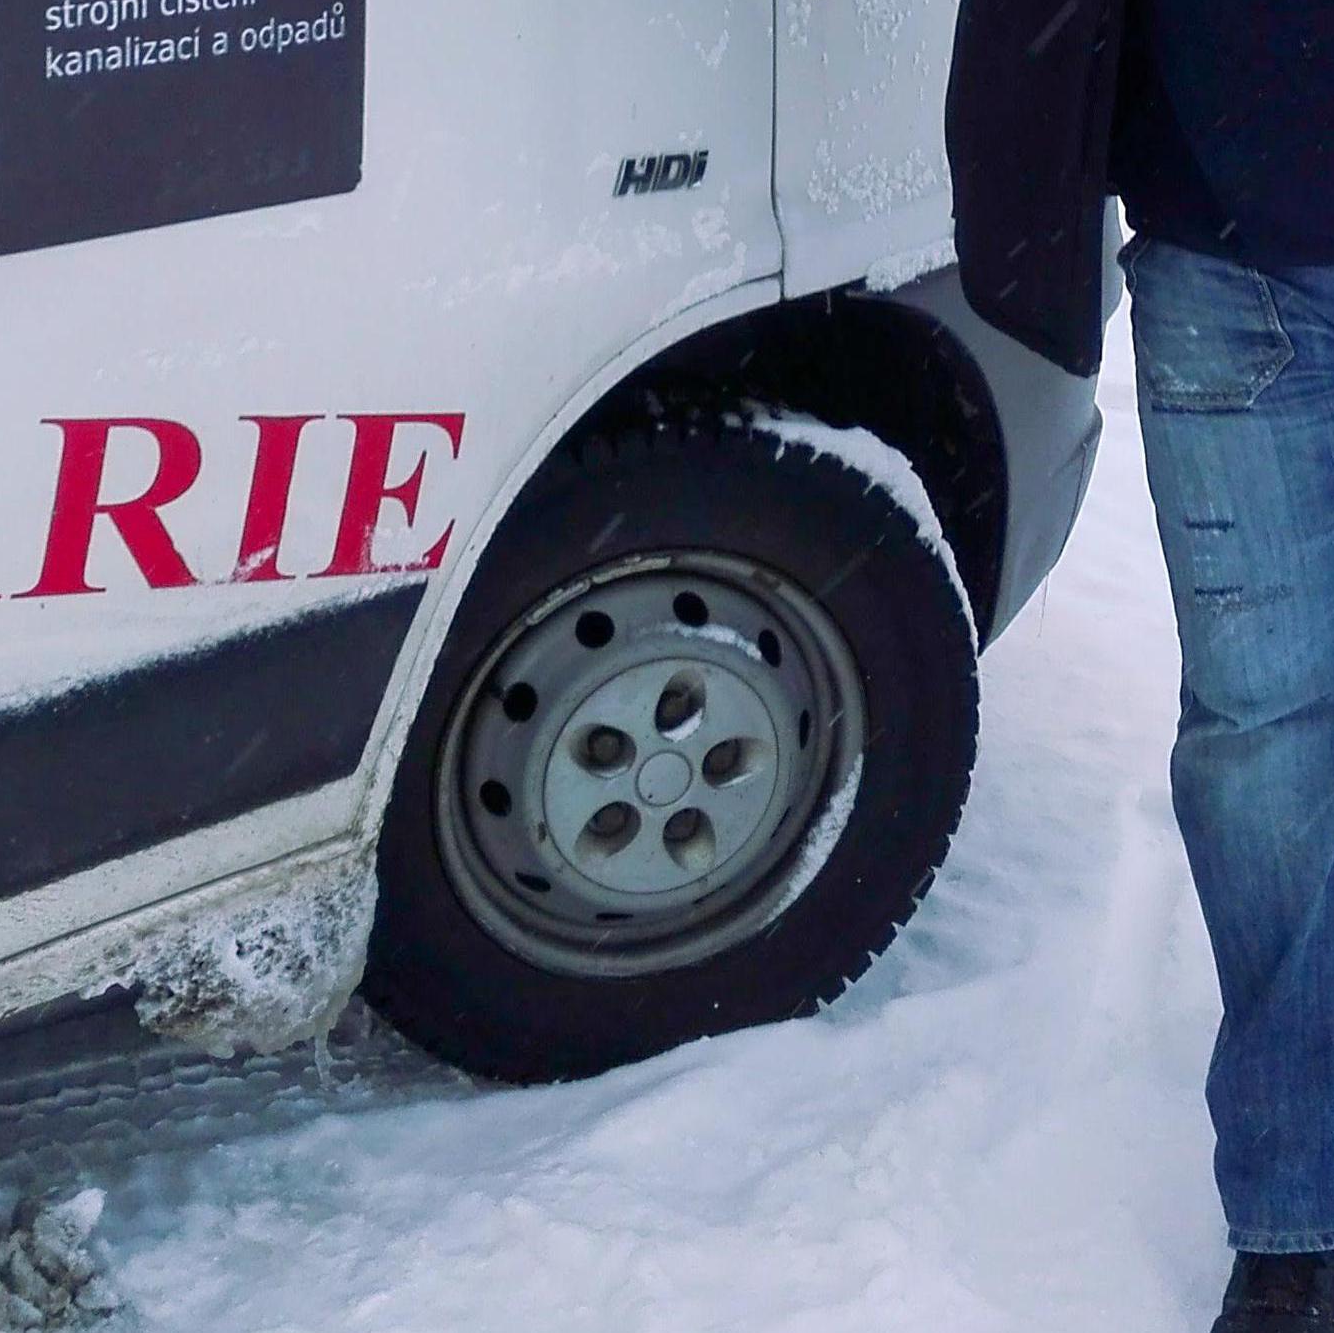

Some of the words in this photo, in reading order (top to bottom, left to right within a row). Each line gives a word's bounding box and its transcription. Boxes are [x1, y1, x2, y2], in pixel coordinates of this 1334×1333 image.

[212, 30, 229, 56] a
[240, 1, 347, 53] odpadů
[612, 149, 709, 198] HDi
